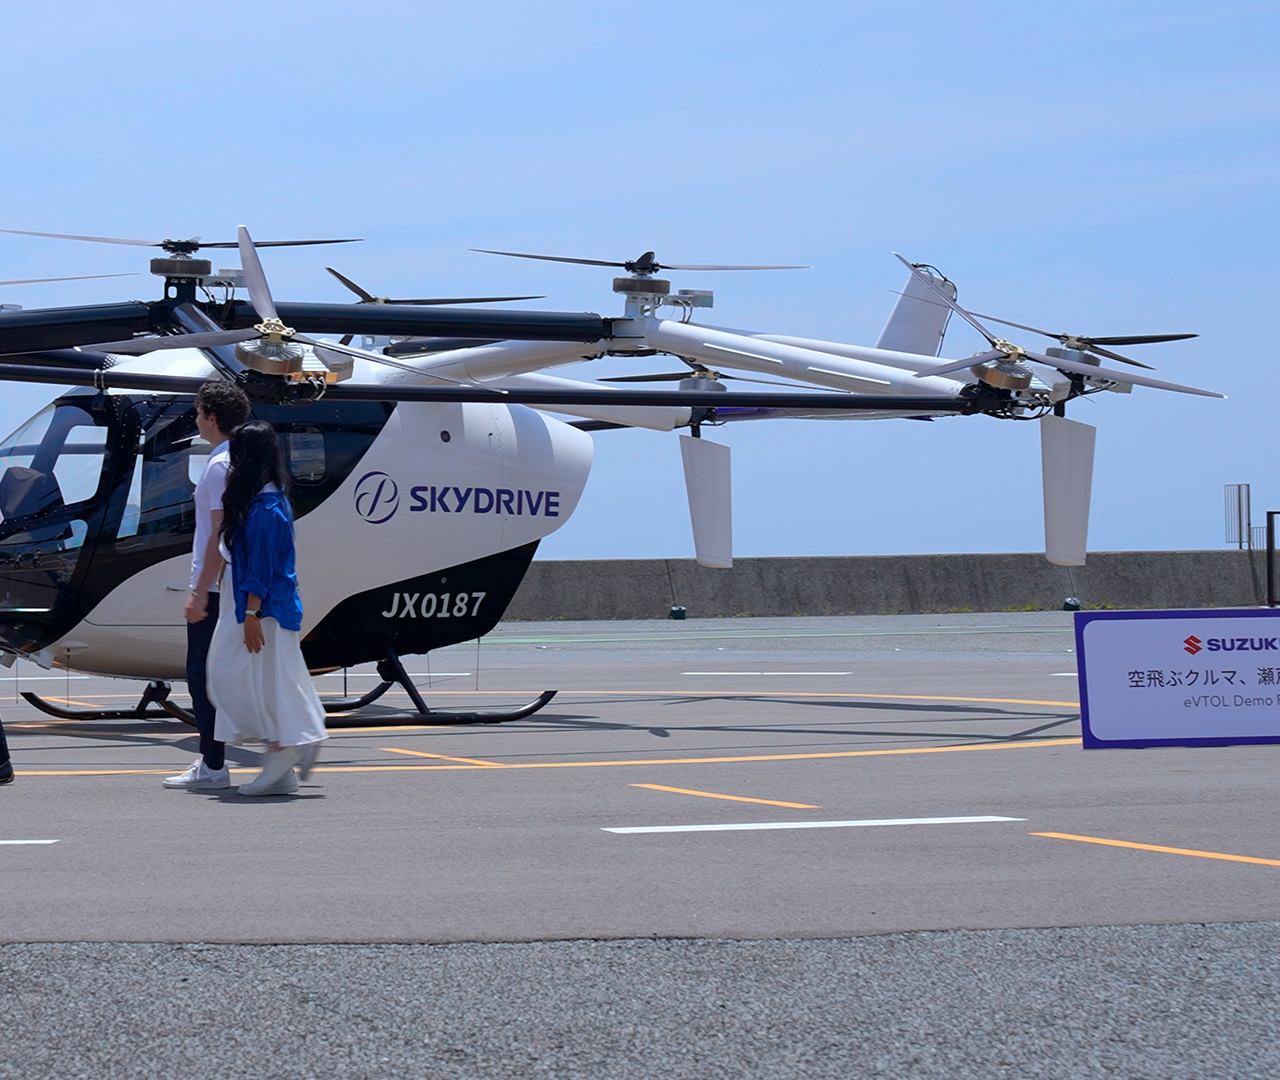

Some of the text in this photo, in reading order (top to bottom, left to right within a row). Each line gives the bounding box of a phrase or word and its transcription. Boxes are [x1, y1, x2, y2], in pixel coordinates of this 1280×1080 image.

[409, 485, 560, 517] SKYDRIVE
[381, 591, 486, 618] JX0187
[1206, 637, 1280, 652] SUZUK
[1127, 667, 1280, 688] 空飛ぶクルマ、瀬
[1183, 695, 1230, 708] eVTOL
[1233, 694, 1273, 707] Demo
